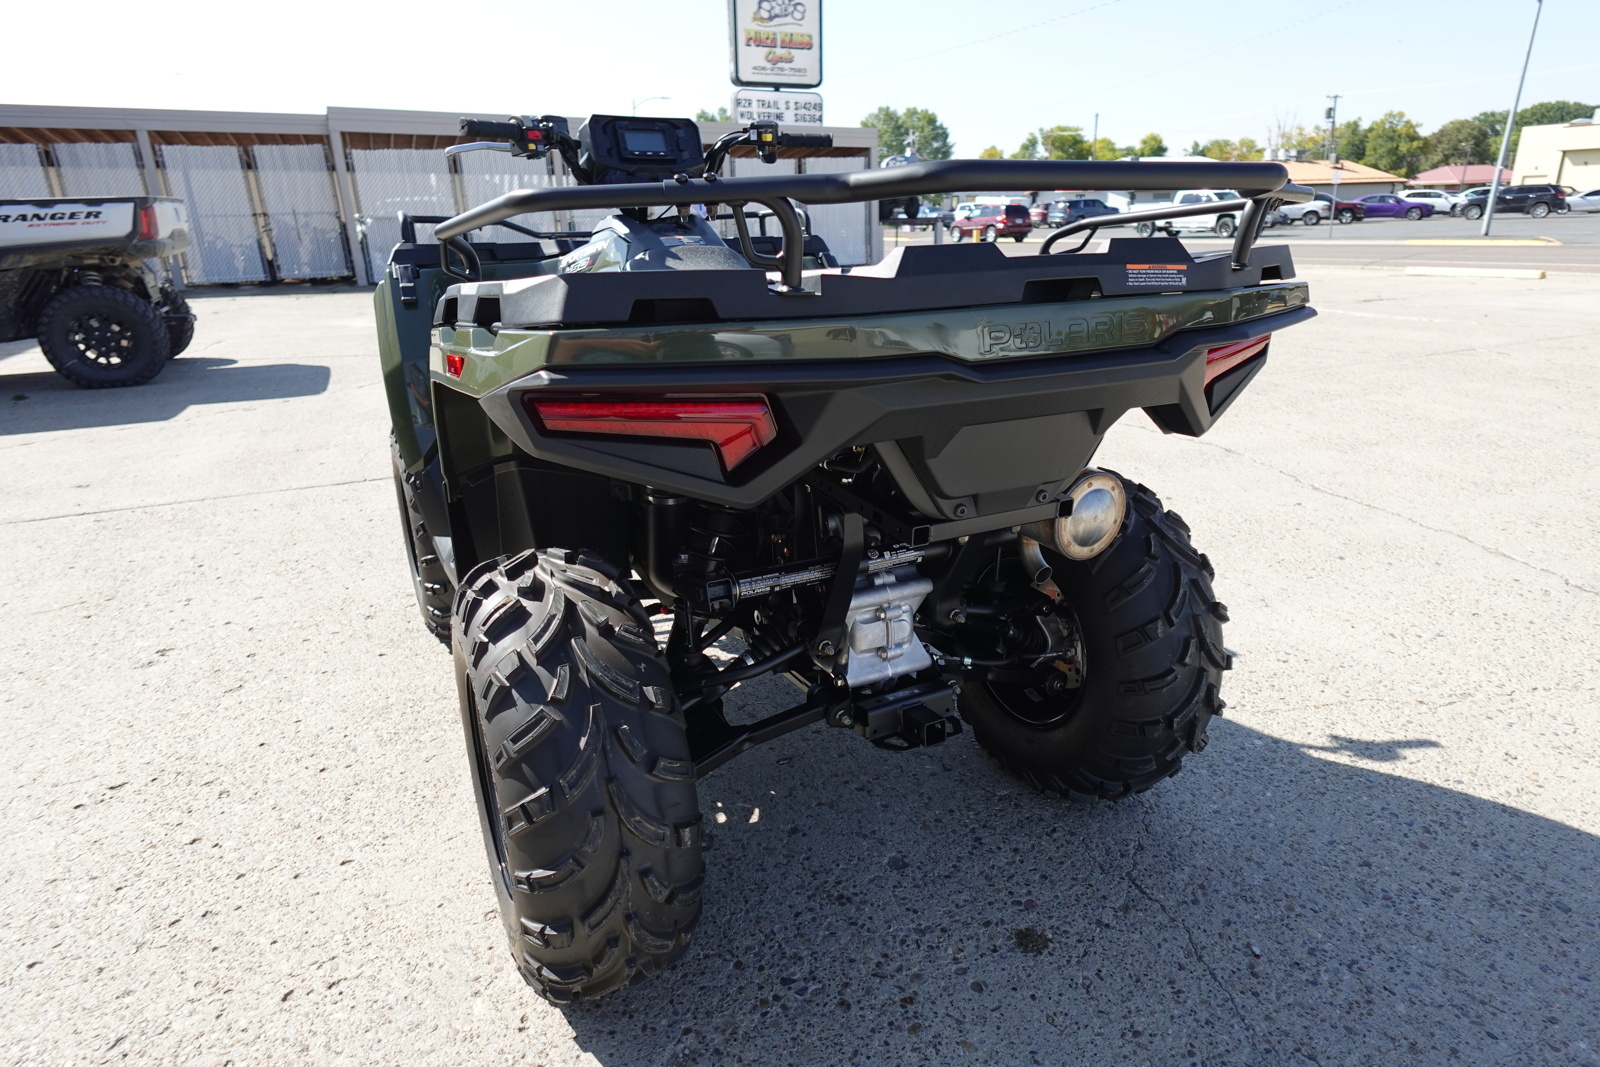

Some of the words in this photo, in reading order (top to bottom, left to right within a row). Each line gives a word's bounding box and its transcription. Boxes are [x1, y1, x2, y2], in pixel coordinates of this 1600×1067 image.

[736, 98, 753, 108] RZR
[756, 99, 781, 110] TRAIL
[785, 100, 791, 111] S
[739, 110, 785, 122] WOLVERINE
[0, 211, 102, 223] RANGER
[979, 313, 1148, 355] POLARIS
